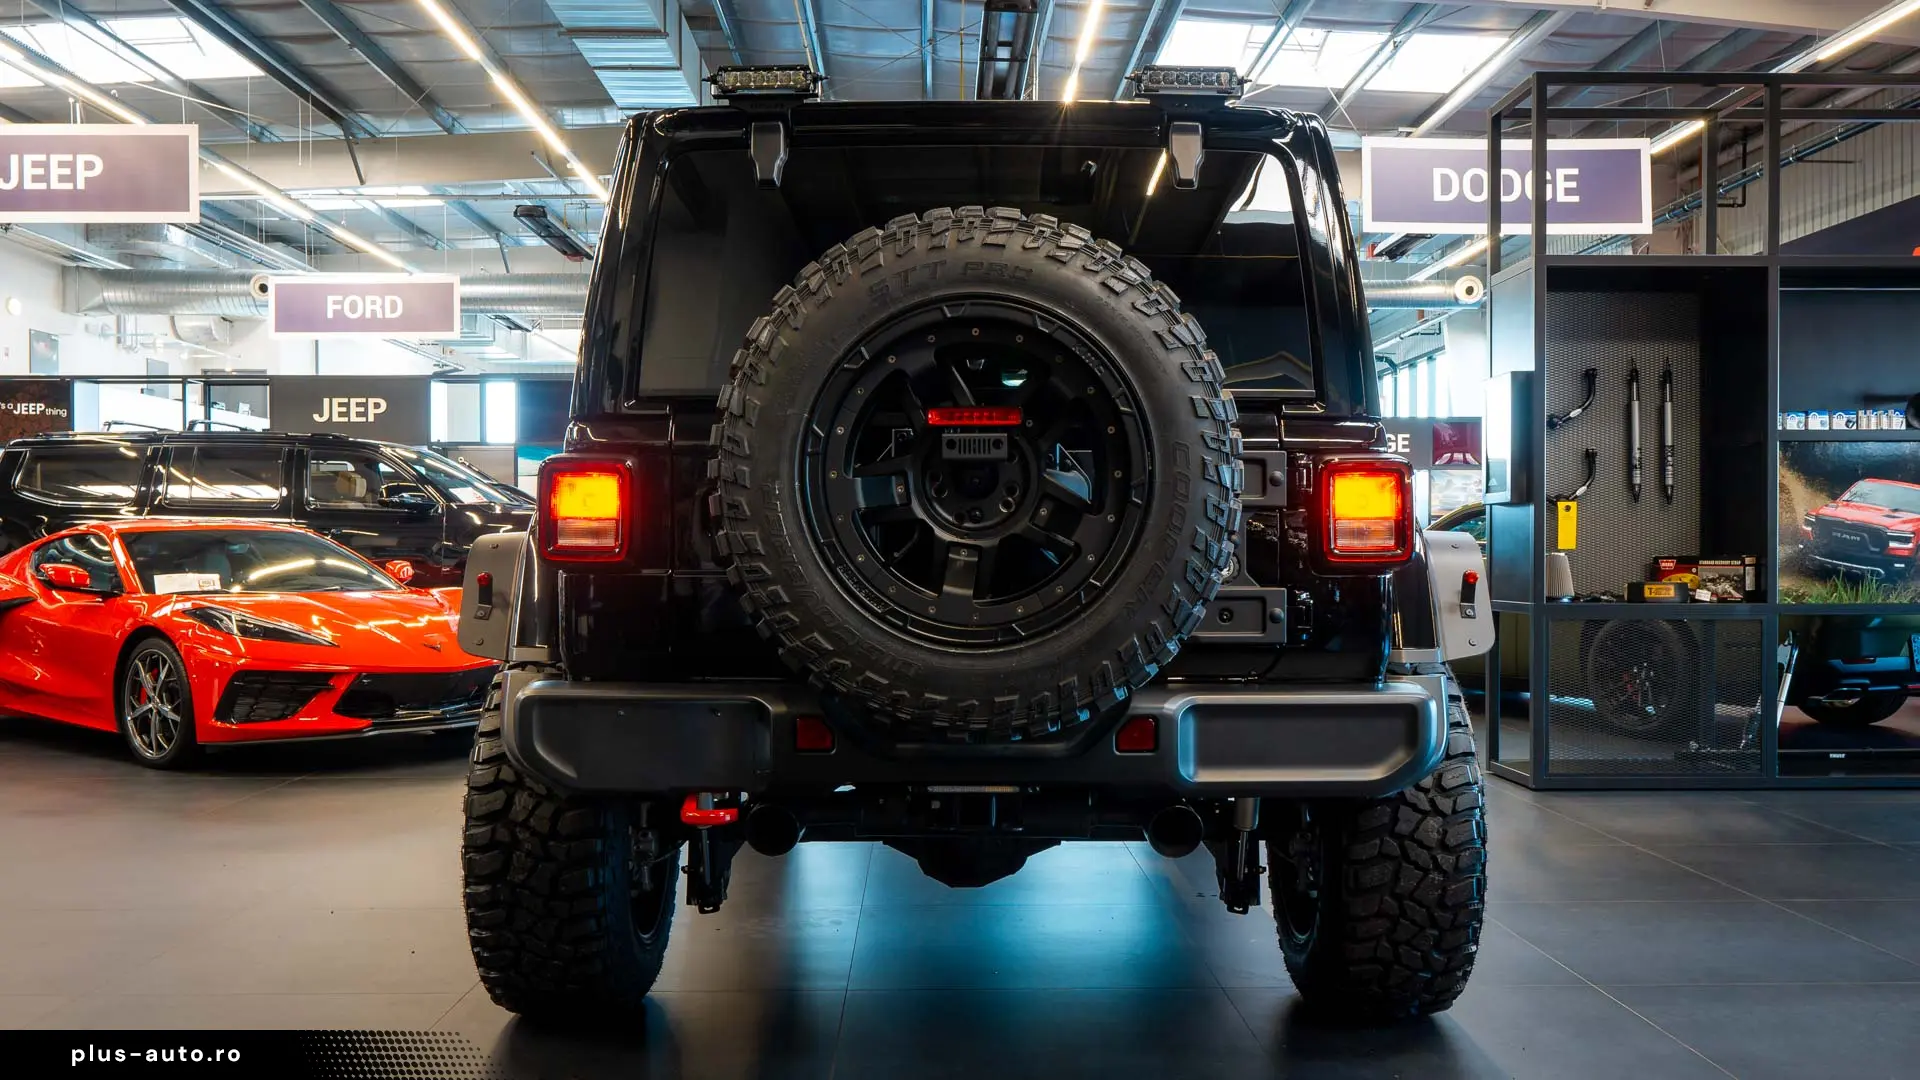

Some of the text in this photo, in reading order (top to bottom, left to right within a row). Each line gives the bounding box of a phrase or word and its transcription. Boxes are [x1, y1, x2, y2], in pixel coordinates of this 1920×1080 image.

[0, 153, 104, 191] JEEP
[325, 295, 404, 319] FORD
[13, 403, 46, 415] JEEP
[46, 408, 67, 417] thing
[313, 397, 387, 423] JEEP
